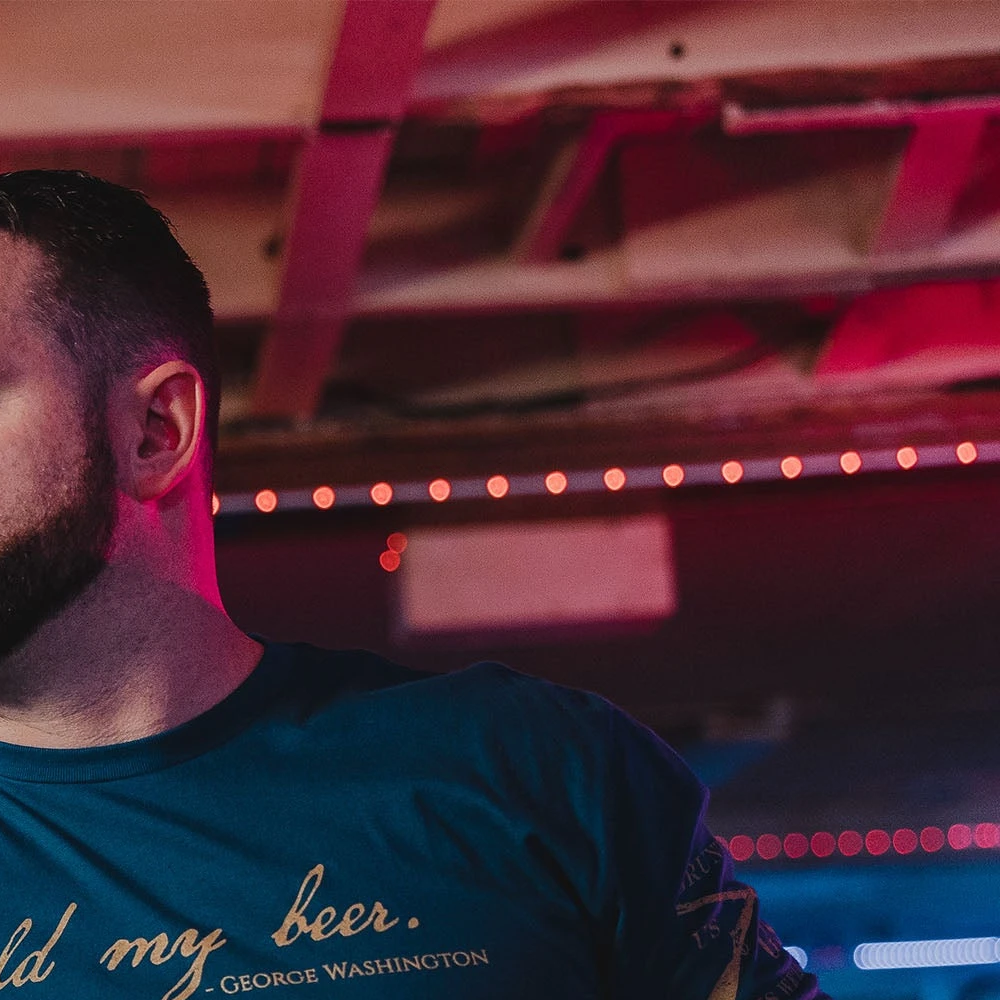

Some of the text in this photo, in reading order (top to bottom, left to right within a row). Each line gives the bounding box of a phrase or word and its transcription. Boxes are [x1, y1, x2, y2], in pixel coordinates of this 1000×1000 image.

[271, 863, 420, 948] beer.
[219, 968, 319, 995] GEORGE
[322, 949, 489, 981] WASHINGTON
